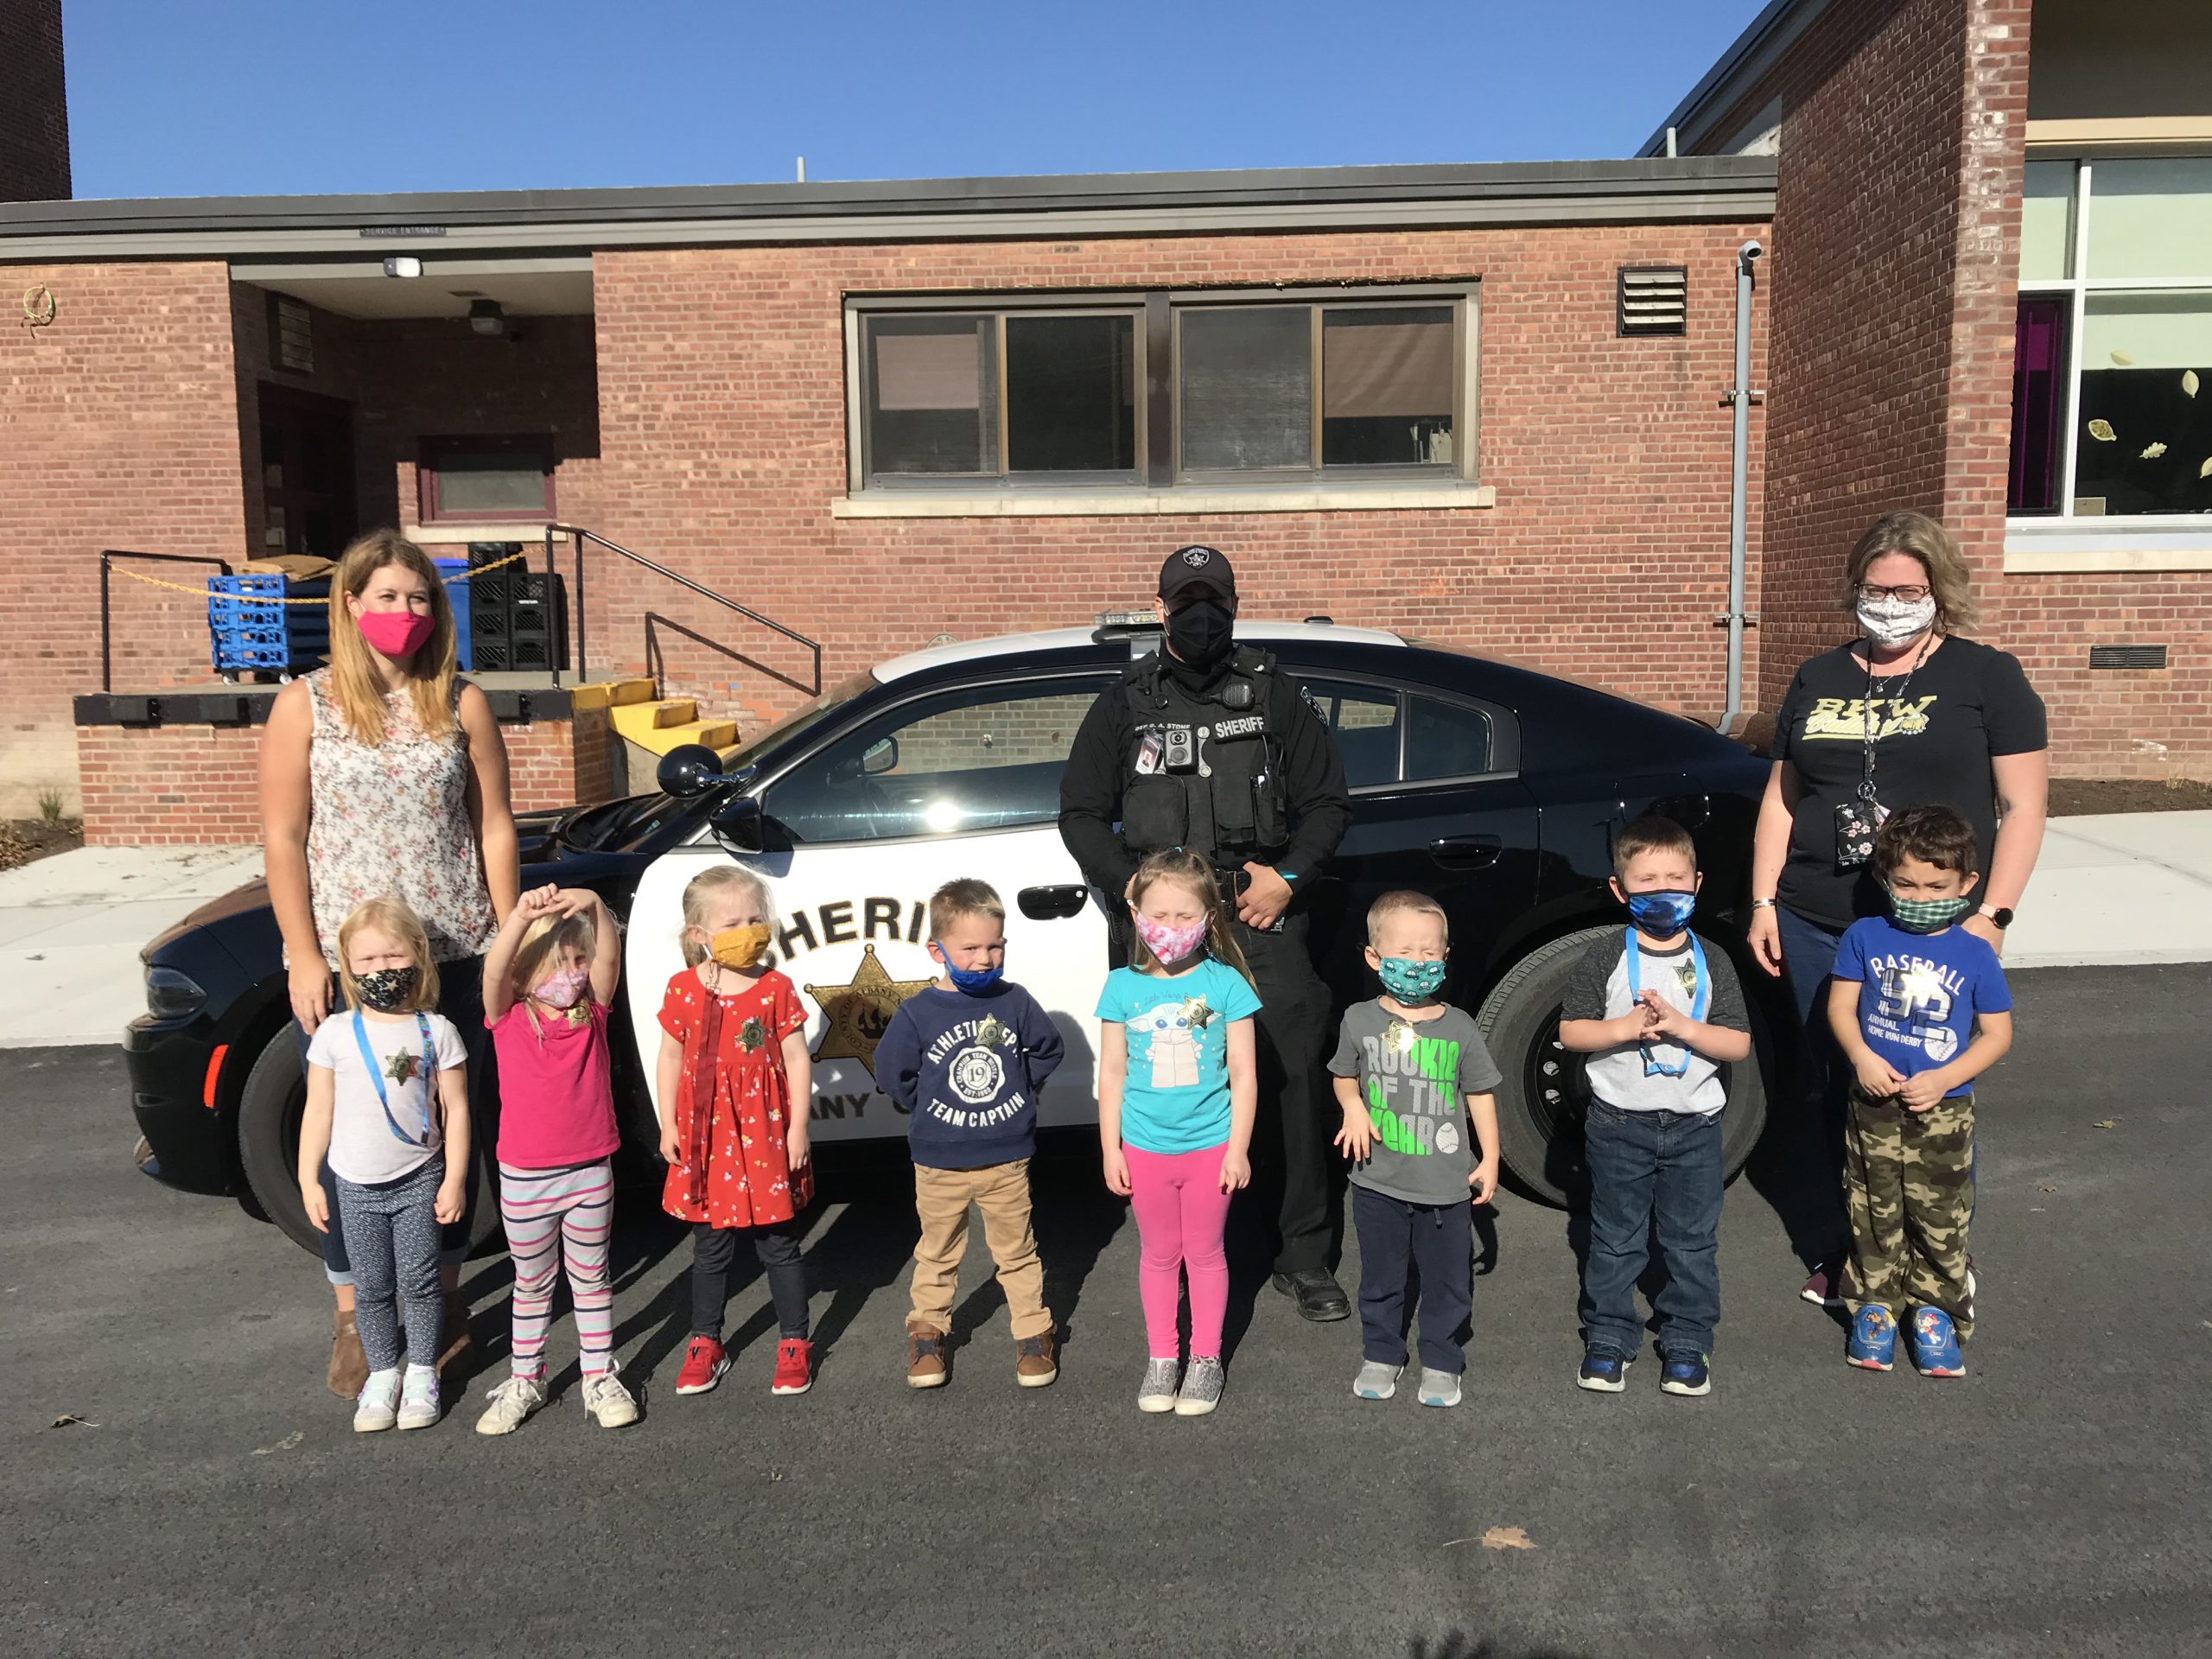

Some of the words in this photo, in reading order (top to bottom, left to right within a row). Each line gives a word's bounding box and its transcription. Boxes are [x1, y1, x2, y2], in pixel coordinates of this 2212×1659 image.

[1810, 696, 1938, 718] BKW
[1215, 716, 1265, 739] SHERIFF
[766, 896, 932, 969] HERI
[1867, 1013, 1900, 1032] ANNUAL
[927, 1020, 988, 1065] ATHLETI
[1868, 1025, 1885, 1038] HOME
[1885, 1030, 1900, 1043] RUN
[1901, 1034, 1923, 1047] DERBY
[969, 1066, 985, 1083] 19
[1368, 1073, 1398, 1109] OF
[926, 1097, 967, 1127] TEAM
[969, 1091, 1026, 1128] CAPTAIN
